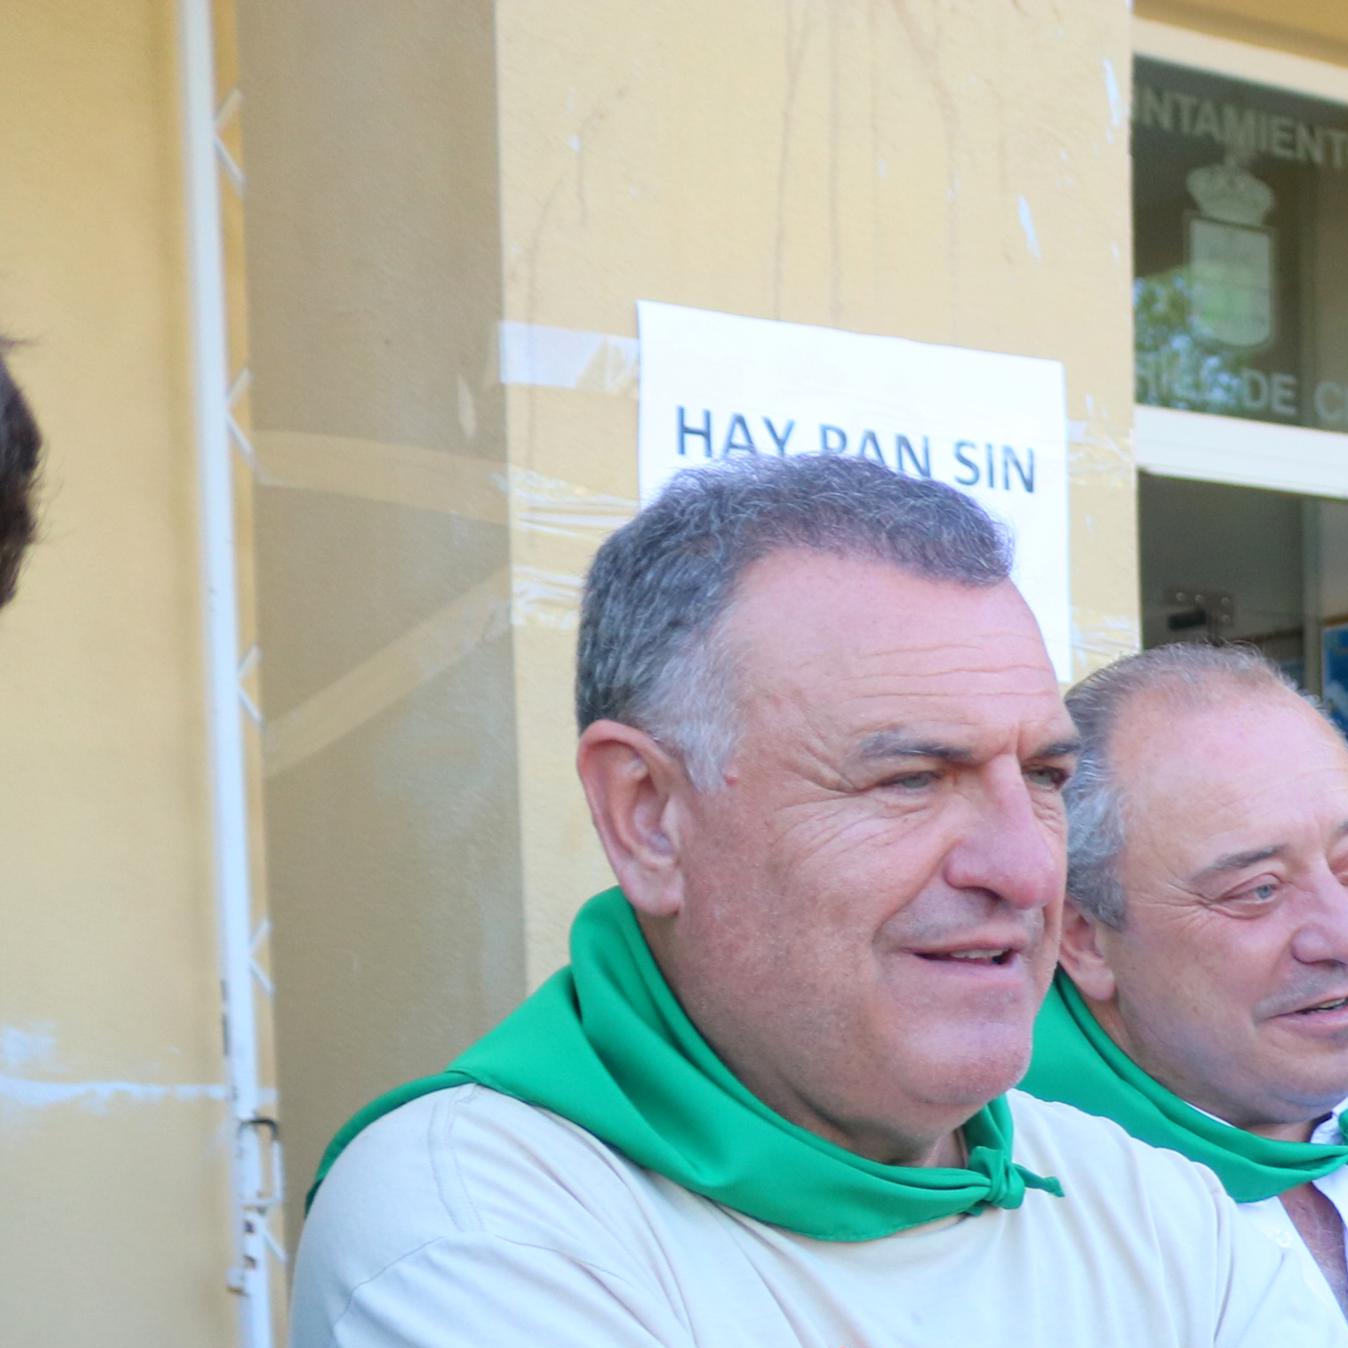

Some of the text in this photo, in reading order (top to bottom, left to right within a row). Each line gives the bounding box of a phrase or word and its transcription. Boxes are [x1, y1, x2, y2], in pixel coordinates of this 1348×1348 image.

[1241, 367, 1298, 416] DE
[675, 405, 1036, 495] HAY PAN SIN
